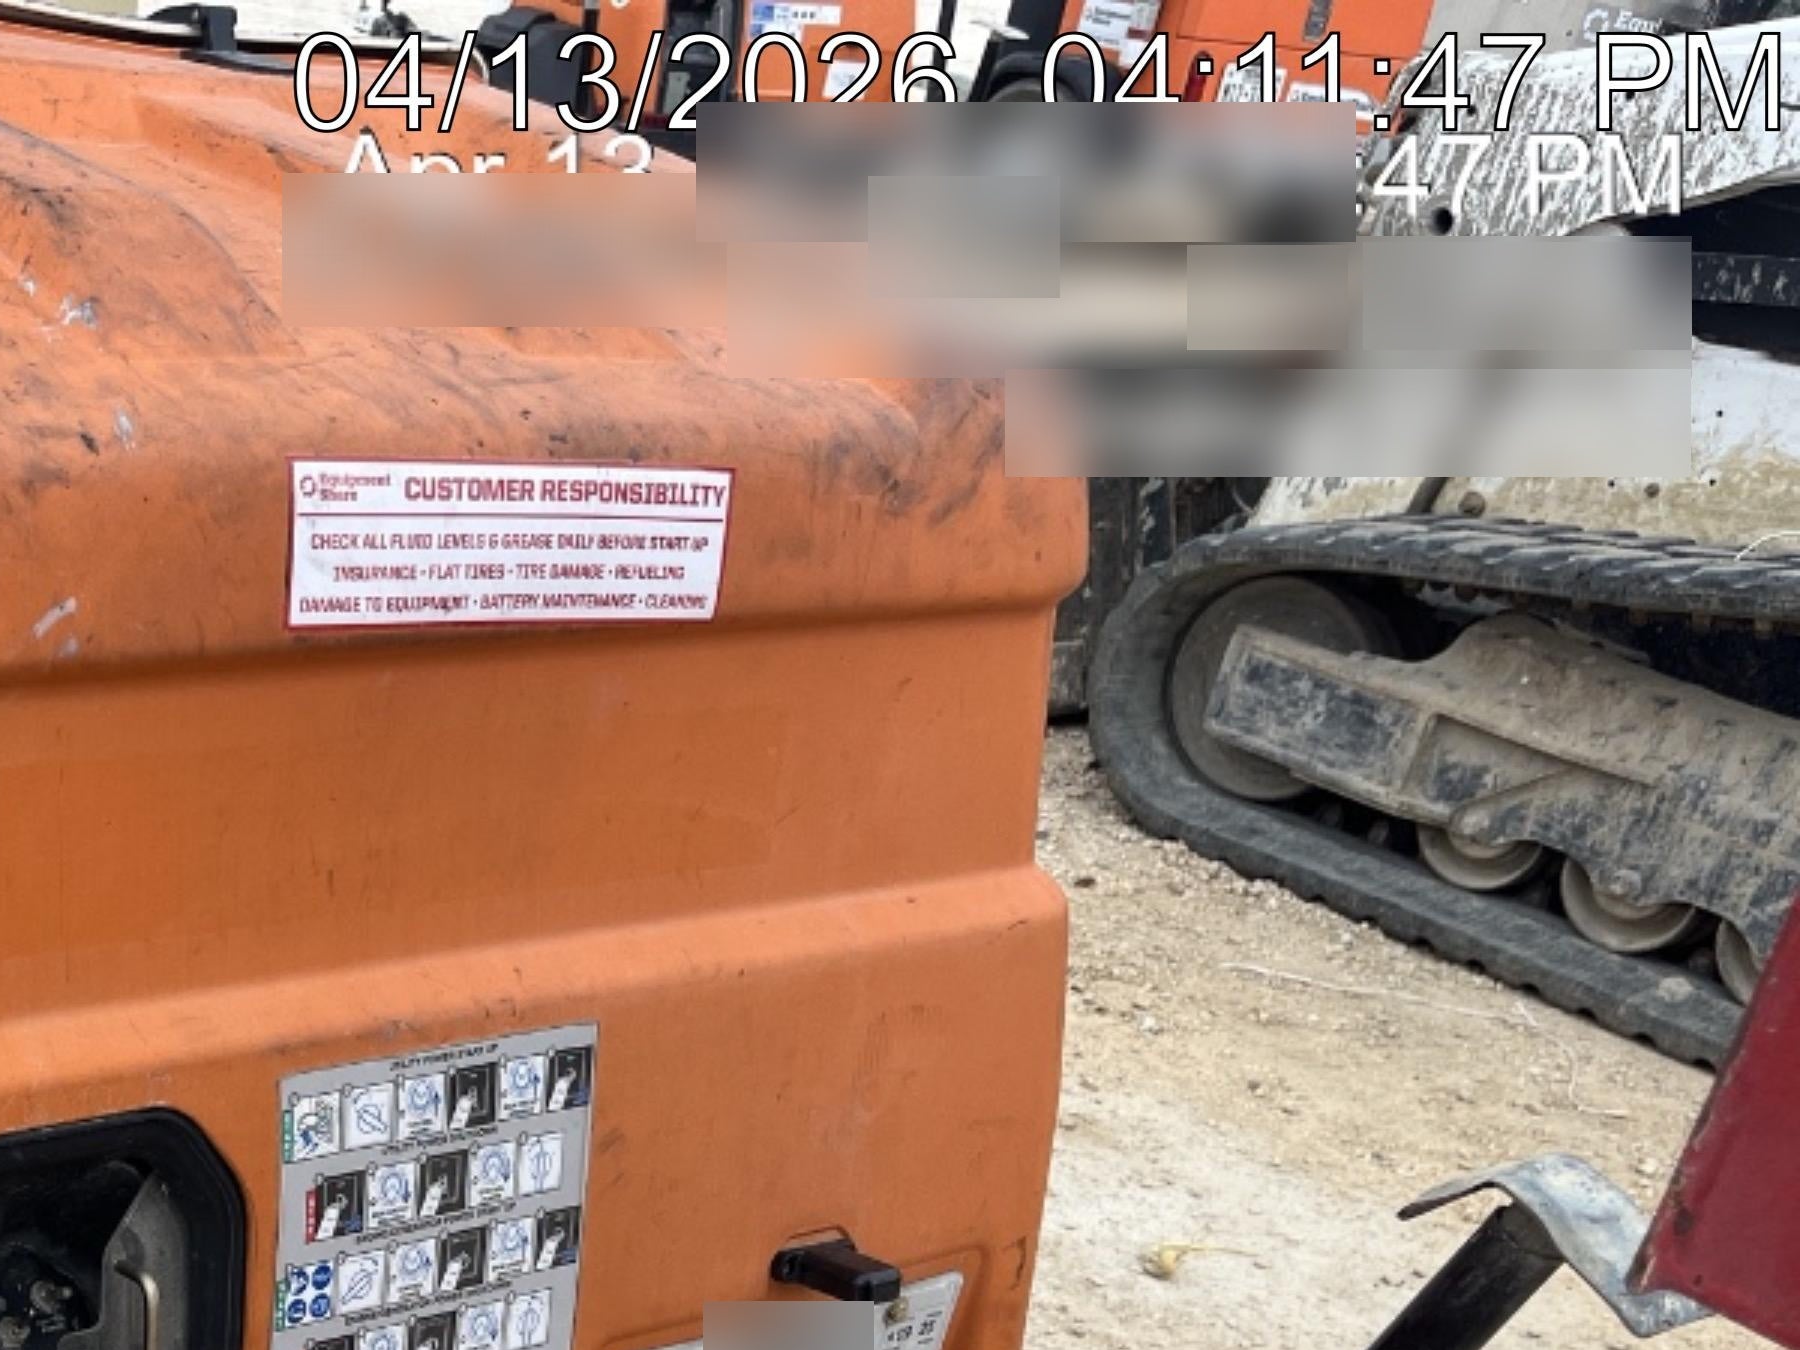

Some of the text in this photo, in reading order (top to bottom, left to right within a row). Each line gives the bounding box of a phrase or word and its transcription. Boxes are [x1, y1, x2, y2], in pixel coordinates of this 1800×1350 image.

[403, 476, 535, 502] CUSTOMER
[539, 479, 726, 508] RESPONSIBILITY
[311, 533, 360, 550] CHECK
[362, 533, 387, 550] ALL
[390, 533, 432, 550] FLUID
[437, 533, 485, 550] LEVELS
[501, 534, 553, 550] GREASE
[557, 534, 594, 550] DAILY
[597, 535, 647, 550] BEFORE
[649, 536, 690, 551] START
[691, 537, 709, 551] UP
[332, 563, 685, 582] INSURANCE FLAT TIRES TIRE DAMAGE REFUELING
[299, 593, 708, 613] DAMAGE TO EQUIPMENT BATTERY MAINTENANCE CLEANING
